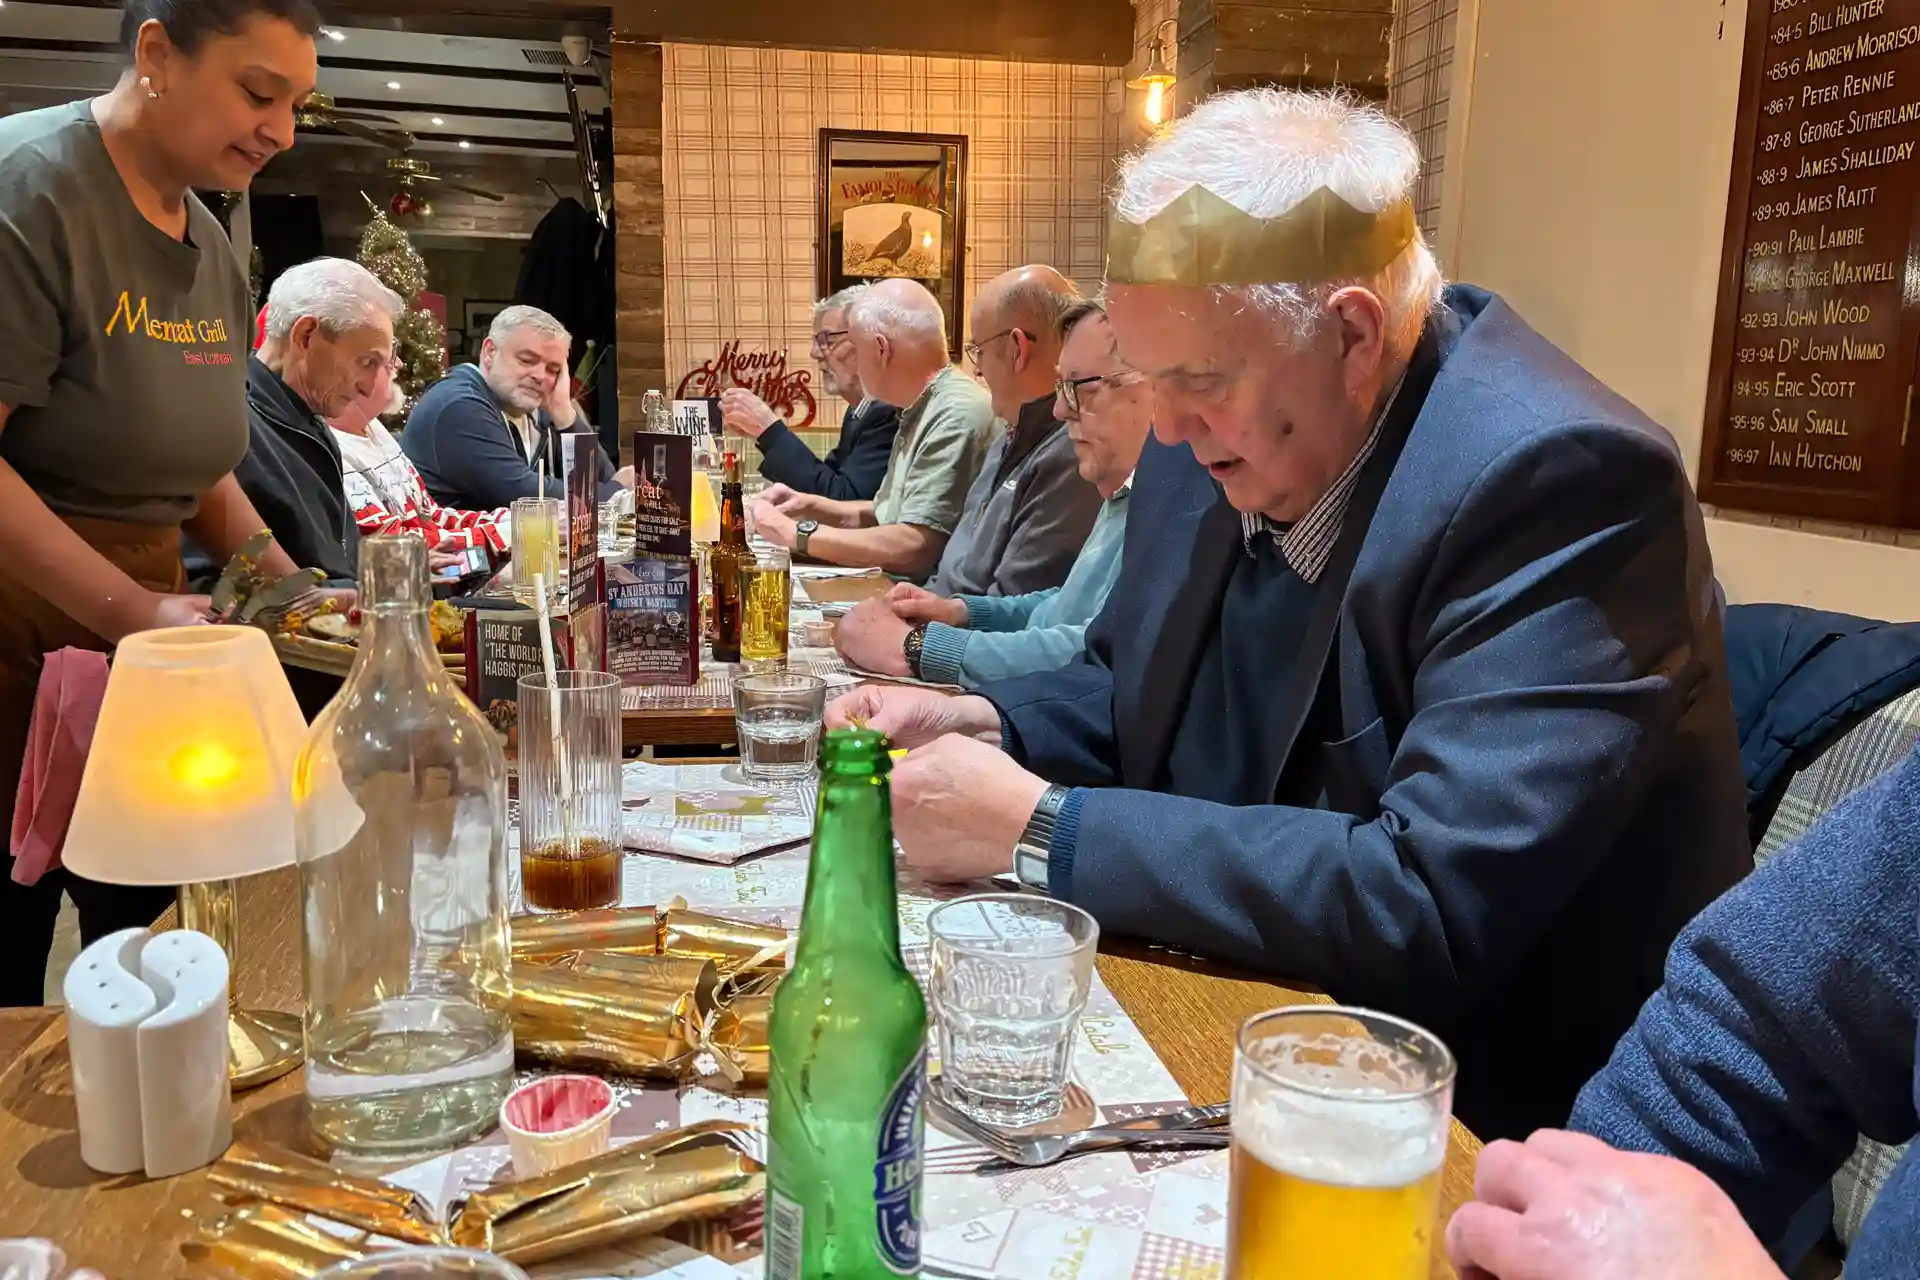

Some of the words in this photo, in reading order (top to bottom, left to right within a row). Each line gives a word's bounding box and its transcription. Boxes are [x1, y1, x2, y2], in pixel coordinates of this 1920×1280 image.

[1809, 12, 1832, 35] BILL
[1836, 0, 1884, 27] HUNTER
[1805, 43, 1855, 72] ANDREW
[1802, 84, 1839, 108] PETER
[1843, 70, 1896, 98] RENNIE
[1800, 119, 1844, 144] GEORGE
[1795, 156, 1837, 179] JAMES
[1840, 141, 1915, 171] SHALLIDAY
[1791, 193, 1832, 216] JAMES
[1836, 184, 1878, 209] RAITT
[1788, 229, 1816, 254] PAUL
[1819, 224, 1865, 249] LAMBIE
[1831, 260, 1895, 285] MAXWELL
[1780, 303, 1818, 327] JOHN
[1823, 299, 1870, 325] WOOD
[197, 318, 228, 343] Grill
[1800, 336, 1838, 361] JOHN
[1840, 335, 1886, 361] NIMMO
[704, 340, 788, 386] Merry
[1775, 371, 1804, 397] ERIC
[1810, 372, 1856, 398] SCOTT
[675, 415, 708, 436] WINE
[1770, 408, 1798, 434] SAM
[1805, 409, 1849, 436] SMALL
[1768, 440, 1791, 467] IAN
[1795, 442, 1862, 472] HUTCHON
[608, 587, 619, 600] ST
[621, 582, 665, 598] ANDREWS
[667, 582, 685, 595] DAY
[485, 623, 510, 640] HOME
[512, 626, 523, 642] OF
[509, 645, 537, 662] WORLD
[485, 659, 517, 678] HAGGIS
